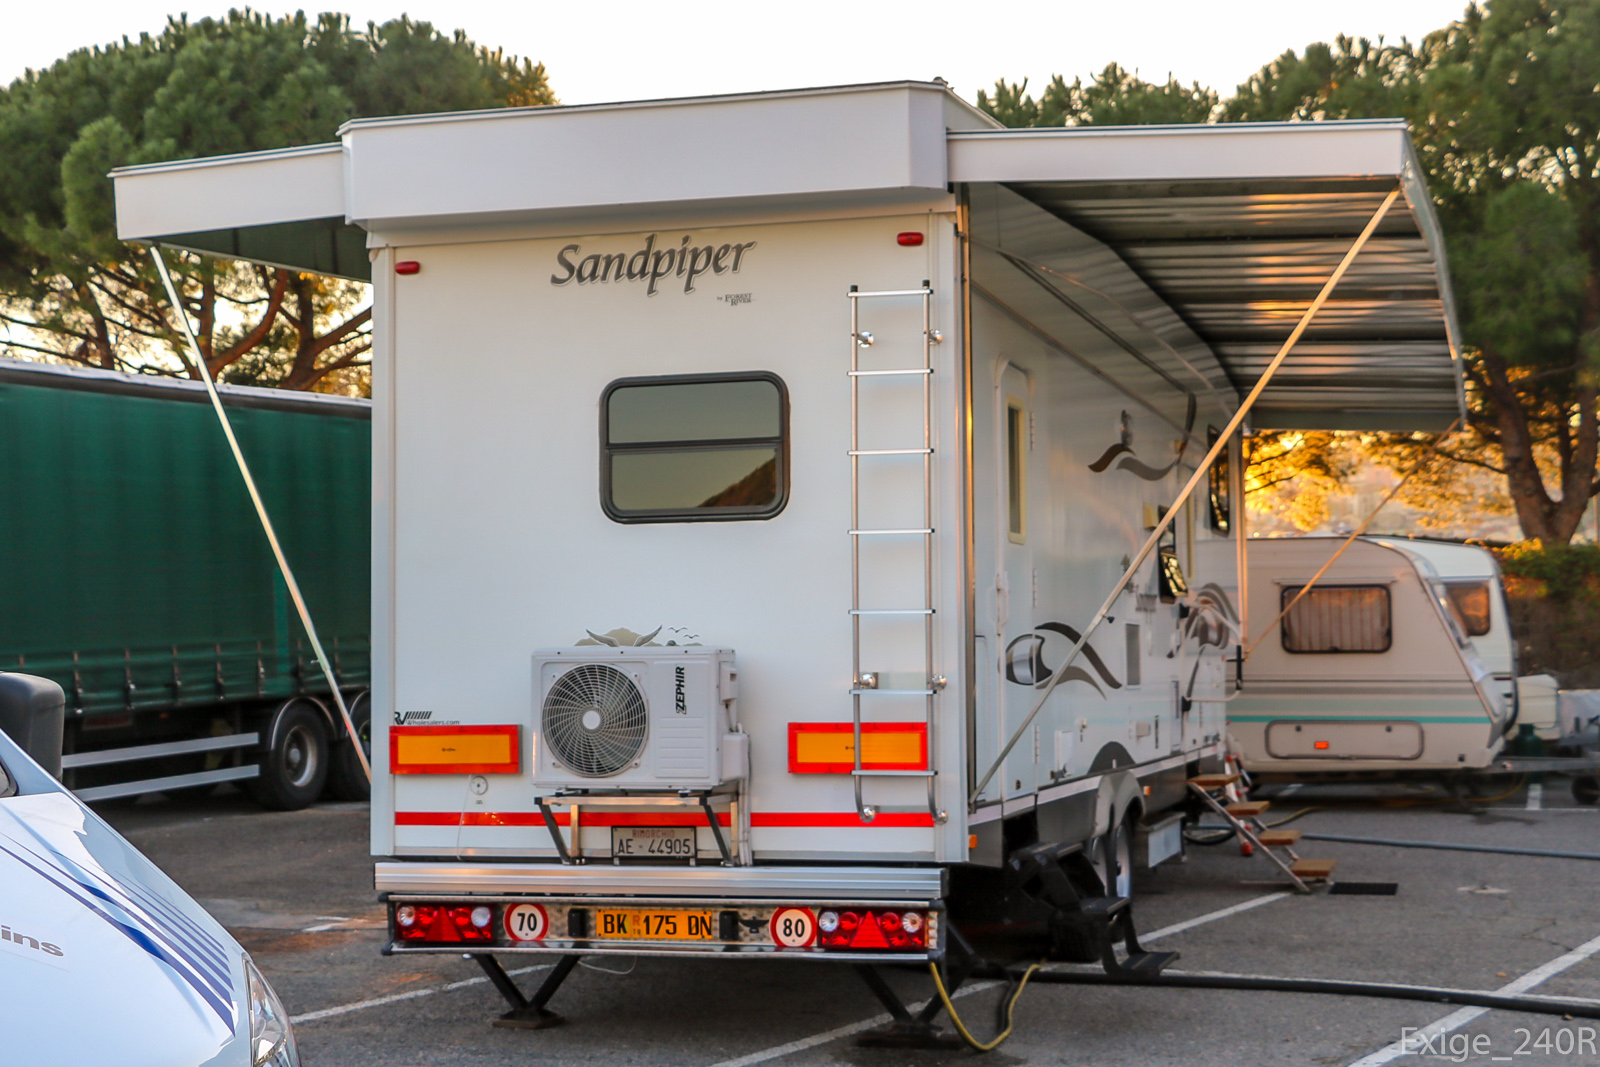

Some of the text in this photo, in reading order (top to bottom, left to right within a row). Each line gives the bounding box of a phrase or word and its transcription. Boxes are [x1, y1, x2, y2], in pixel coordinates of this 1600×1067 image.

[550, 233, 756, 296] Sandpiper
[675, 666, 686, 715] ZEPHIR
[632, 829, 676, 838] RIMORCHIO
[618, 839, 691, 854] AE 44905
[517, 912, 537, 932] 70
[603, 914, 628, 934] BK
[643, 915, 677, 935] 175
[783, 918, 805, 938] 80
